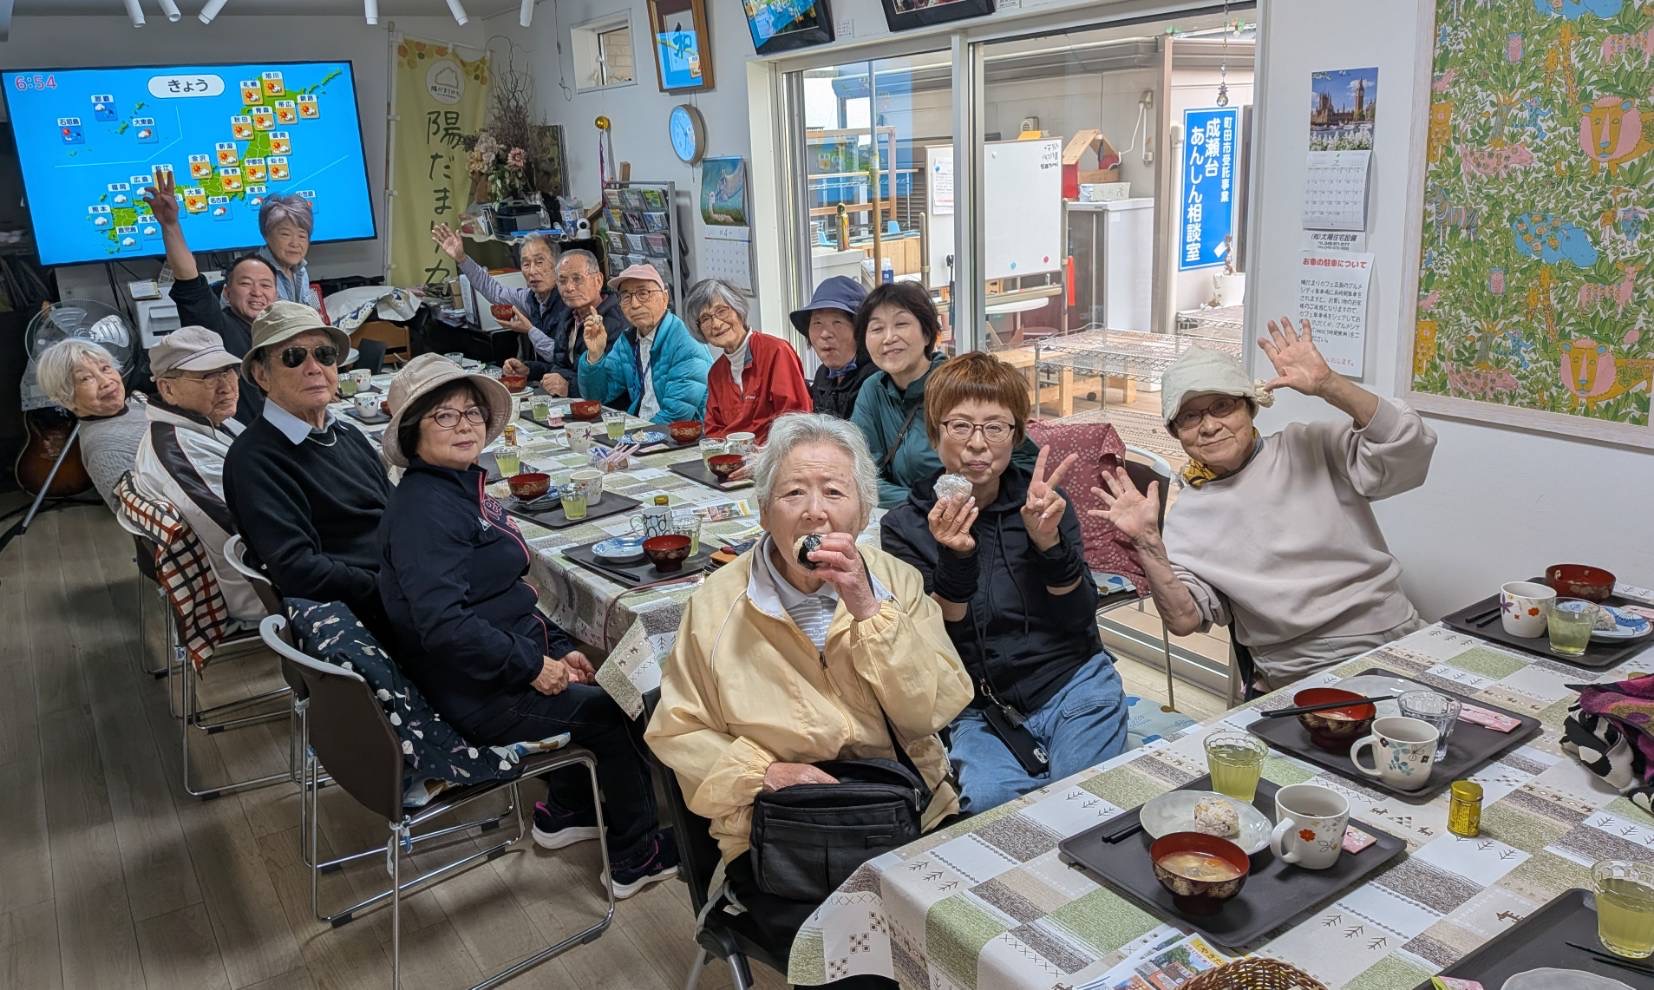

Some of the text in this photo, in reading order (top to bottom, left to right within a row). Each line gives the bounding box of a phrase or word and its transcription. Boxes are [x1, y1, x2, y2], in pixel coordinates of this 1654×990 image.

[15, 75, 57, 91] 6:54
[168, 79, 209, 93] きょう
[1204, 117, 1221, 178] 成瀬台
[1220, 116, 1233, 203] 町田市受託事業
[1185, 126, 1205, 262] あんしん相談室
[1302, 257, 1368, 269] お車の駐車について
